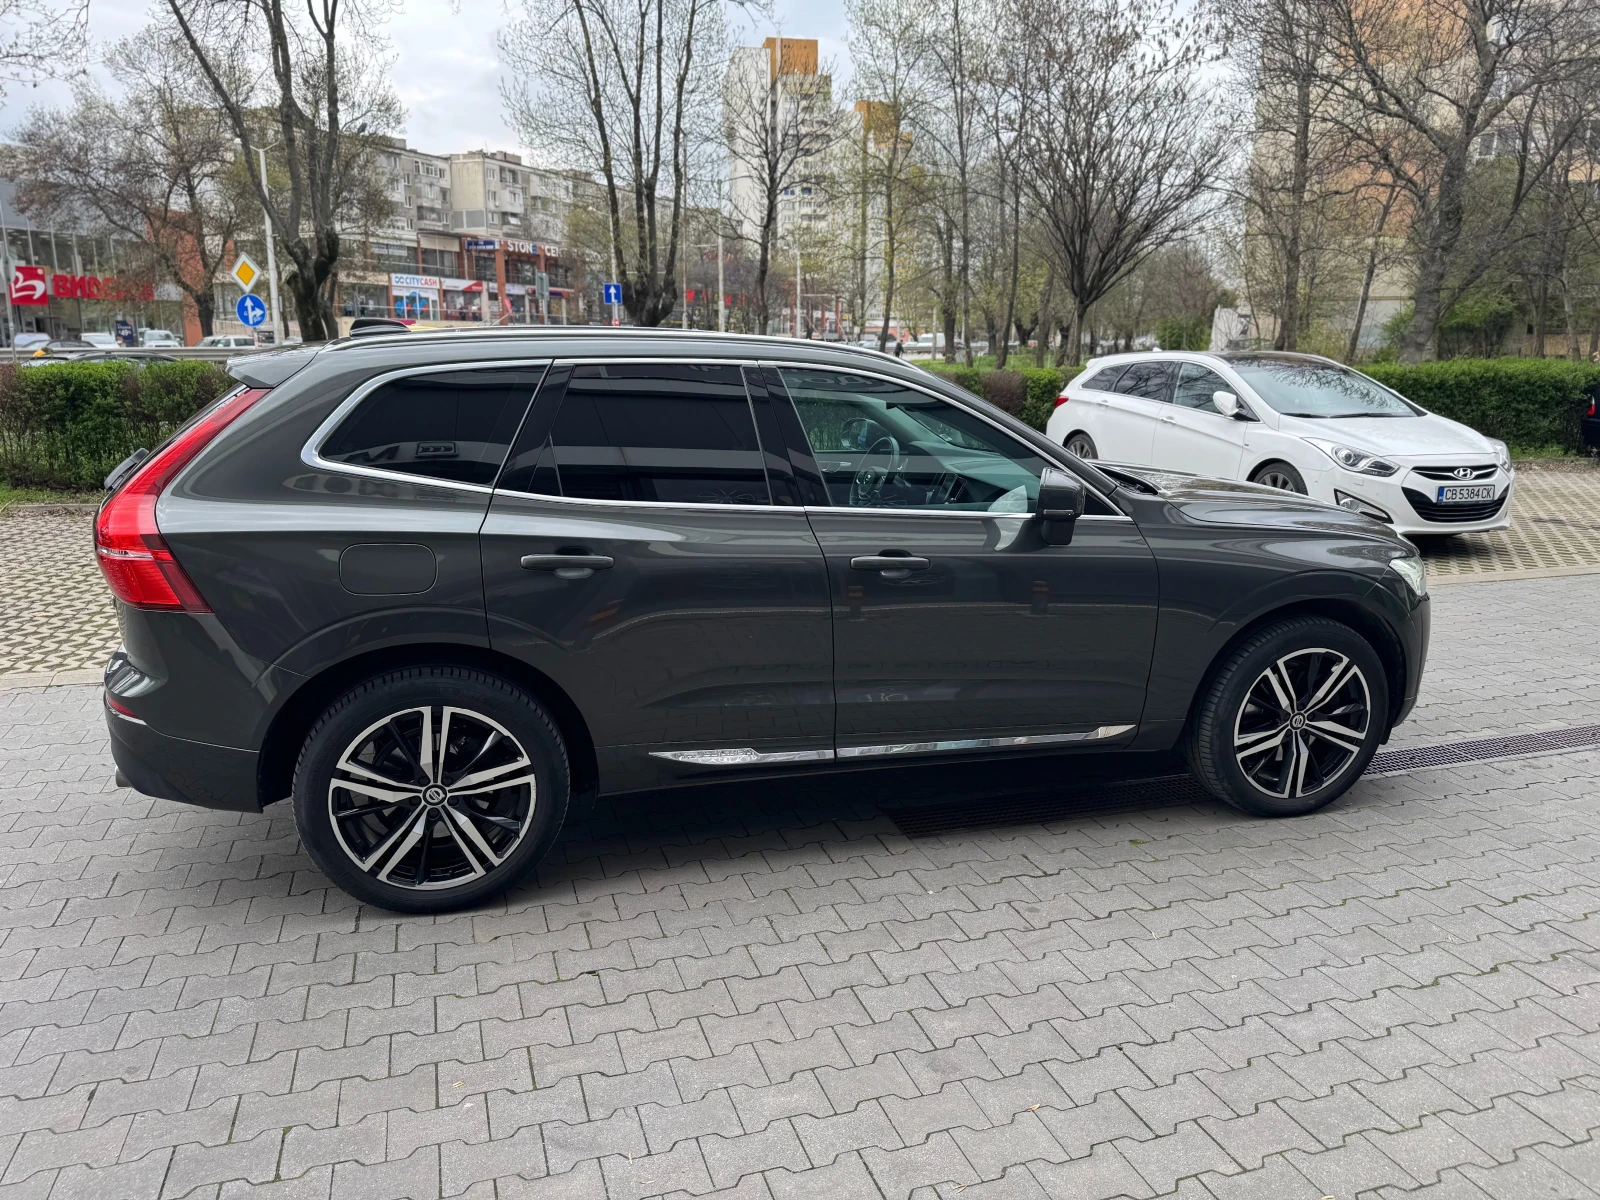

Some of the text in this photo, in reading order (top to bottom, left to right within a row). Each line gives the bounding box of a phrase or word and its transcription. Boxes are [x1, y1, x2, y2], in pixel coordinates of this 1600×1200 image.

[1445, 487, 1493, 500] CB 5384 CK
